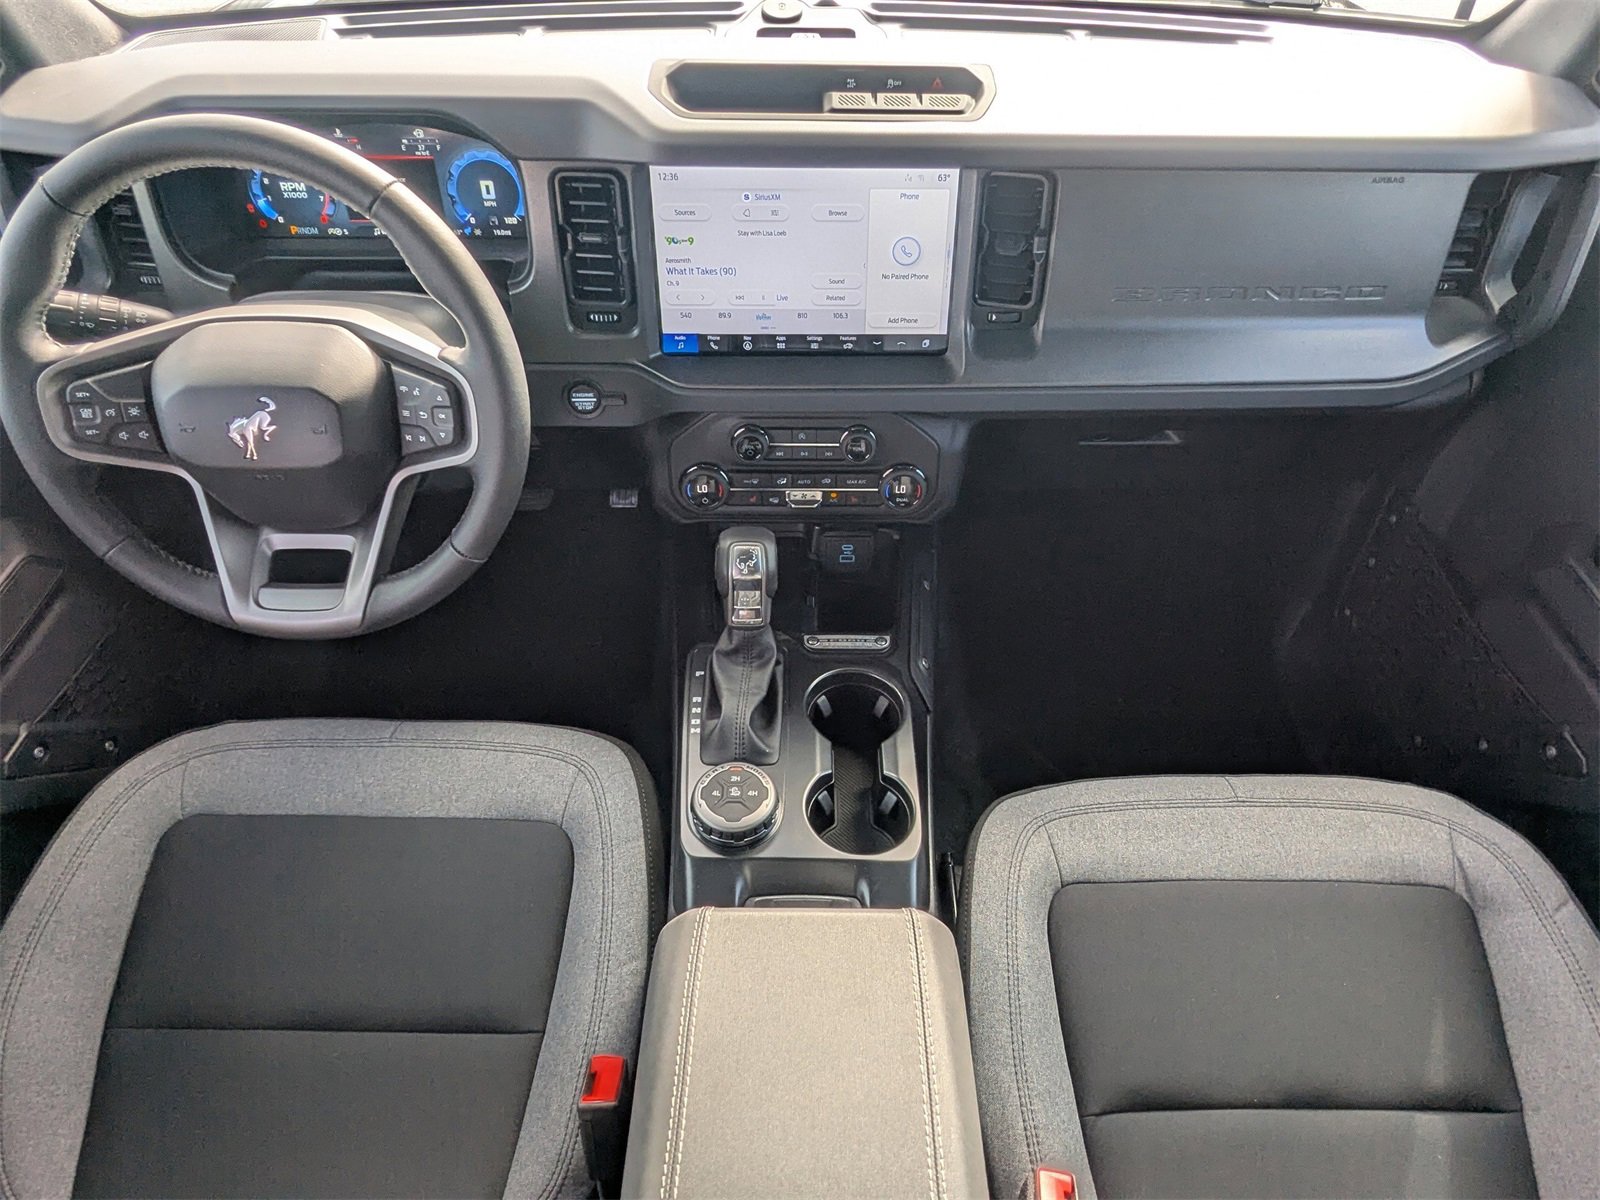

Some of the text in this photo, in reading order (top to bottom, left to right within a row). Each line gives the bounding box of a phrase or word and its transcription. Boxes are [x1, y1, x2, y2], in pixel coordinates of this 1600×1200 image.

[658, 172, 679, 181] 12:36
[279, 181, 307, 192] RPM
[283, 191, 308, 199] X1000
[754, 193, 781, 201] SiriusXM
[900, 193, 920, 201] Phone
[483, 200, 497, 208] MPH
[503, 216, 519, 224] 120
[737, 230, 749, 238] Stay
[665, 267, 737, 277] What It Takes (90)
[776, 294, 789, 302] Live
[1112, 286, 1387, 302] BRONCO
[833, 312, 849, 320] 106.3
[887, 316, 918, 324] Add Phone
[895, 485, 906, 494] LO
